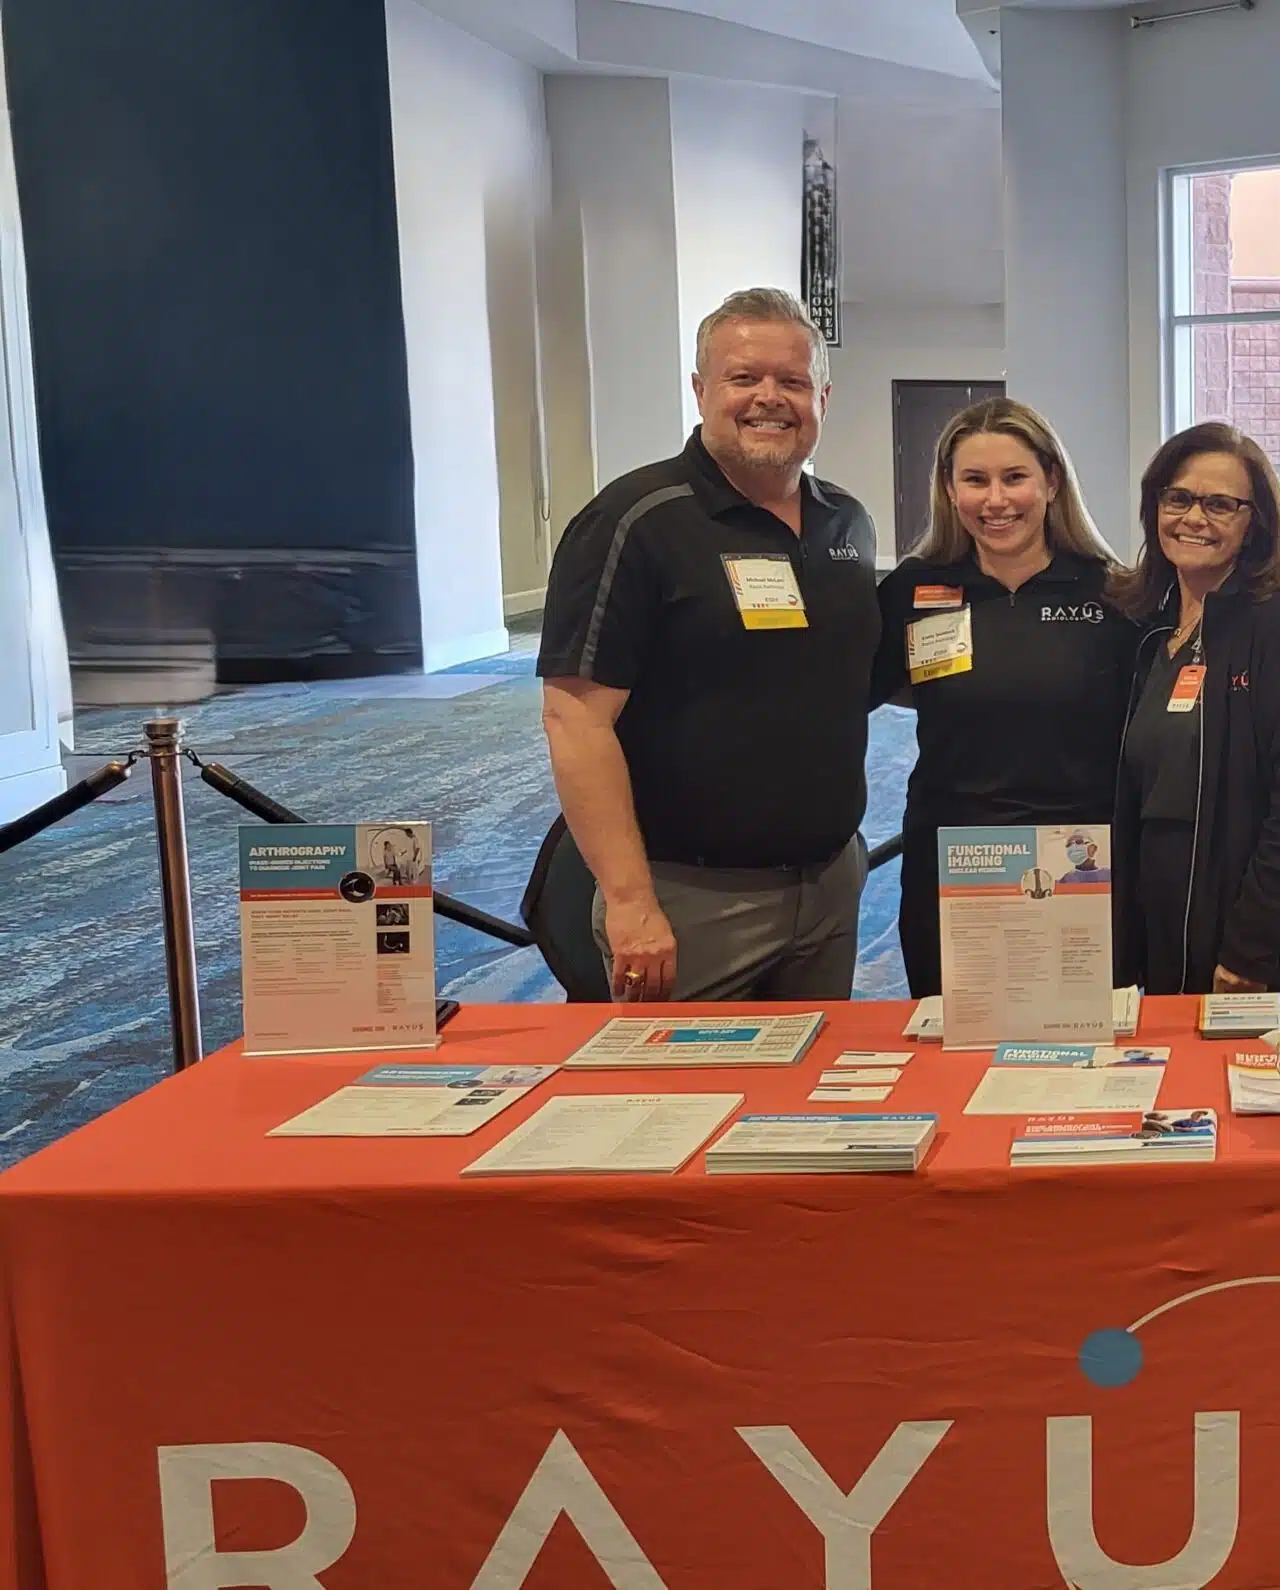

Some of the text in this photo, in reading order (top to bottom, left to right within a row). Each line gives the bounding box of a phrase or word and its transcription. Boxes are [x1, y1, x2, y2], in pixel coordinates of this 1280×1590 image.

[1041, 605, 1104, 620] RAYUS
[249, 847, 346, 857] ARTHROGRAPHY
[948, 844, 1031, 855] FUNCTIONAL
[948, 856, 1003, 866] IMAGING
